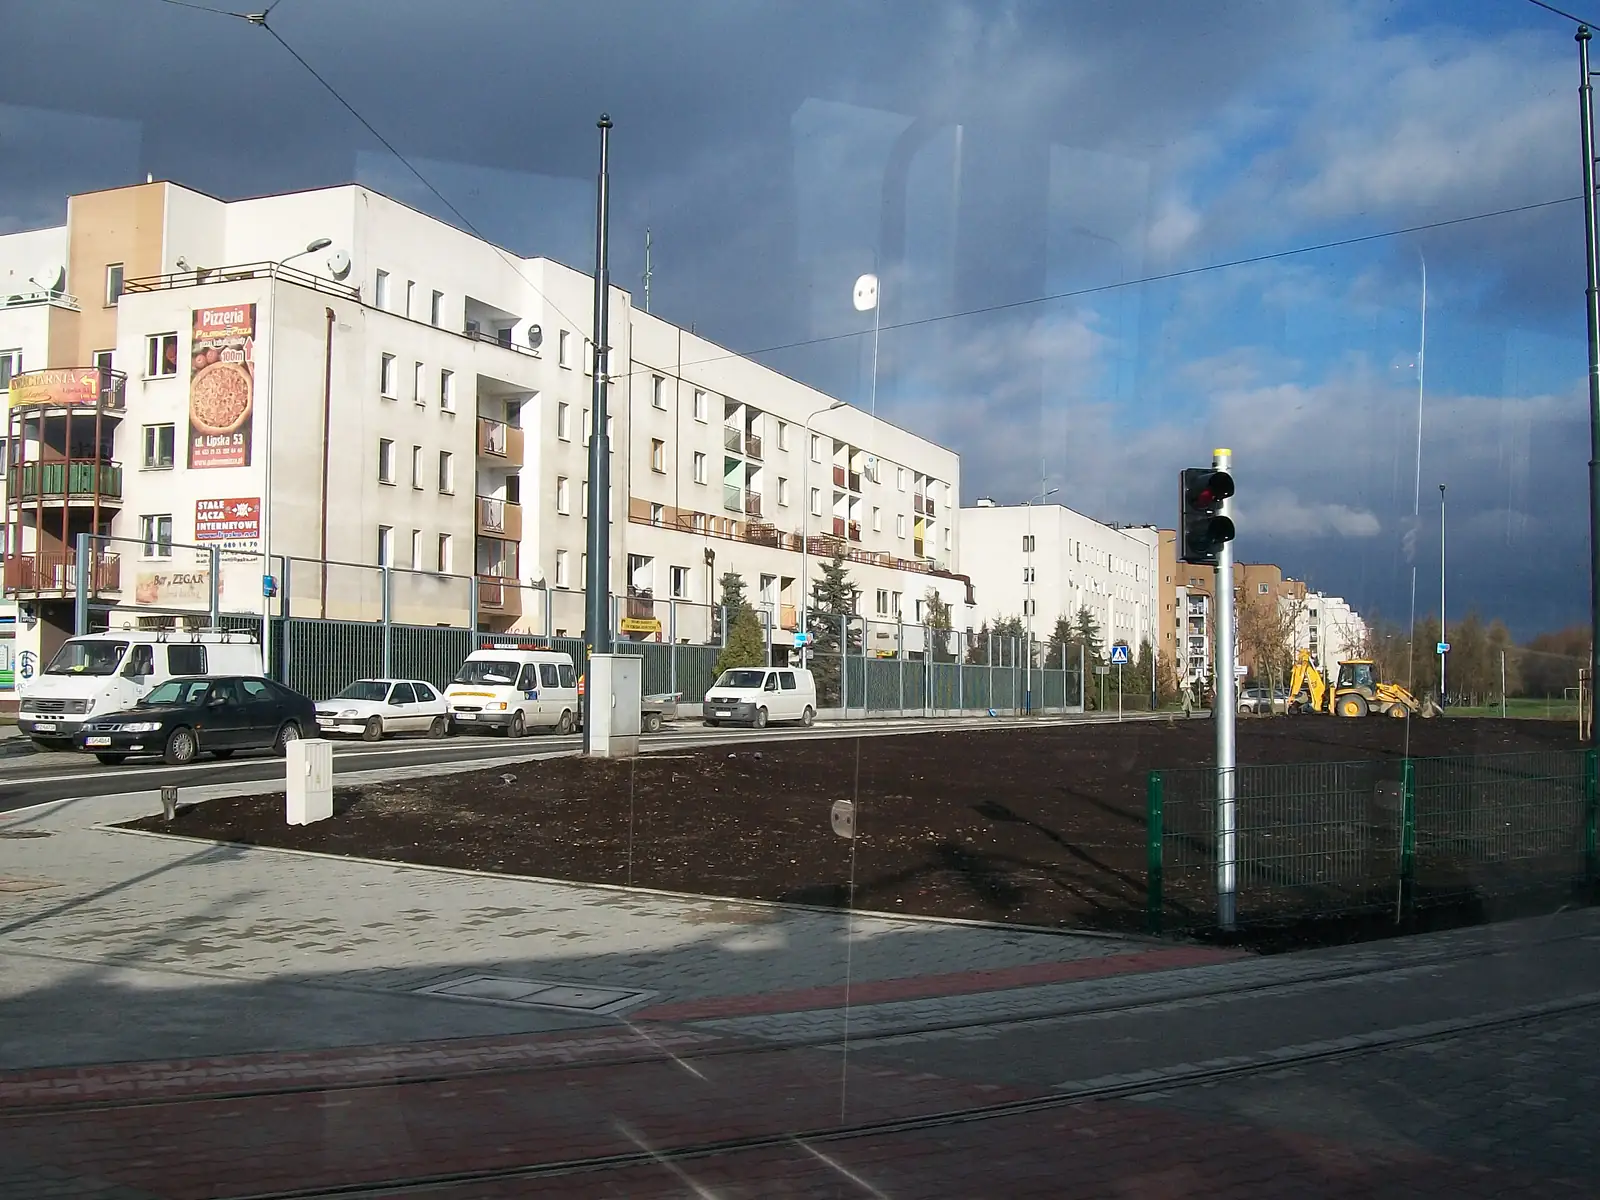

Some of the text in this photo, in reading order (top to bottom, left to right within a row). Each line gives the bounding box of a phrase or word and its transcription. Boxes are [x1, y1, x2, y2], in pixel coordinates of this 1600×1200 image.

[203, 308, 243, 326] Pizzeria
[222, 350, 243, 362] 100m
[195, 433, 243, 448] ul. Lipska 53
[197, 500, 225, 510] STAŁE
[197, 511, 225, 521] ŁĄCZA
[196, 520, 258, 531] INTERNETOWE
